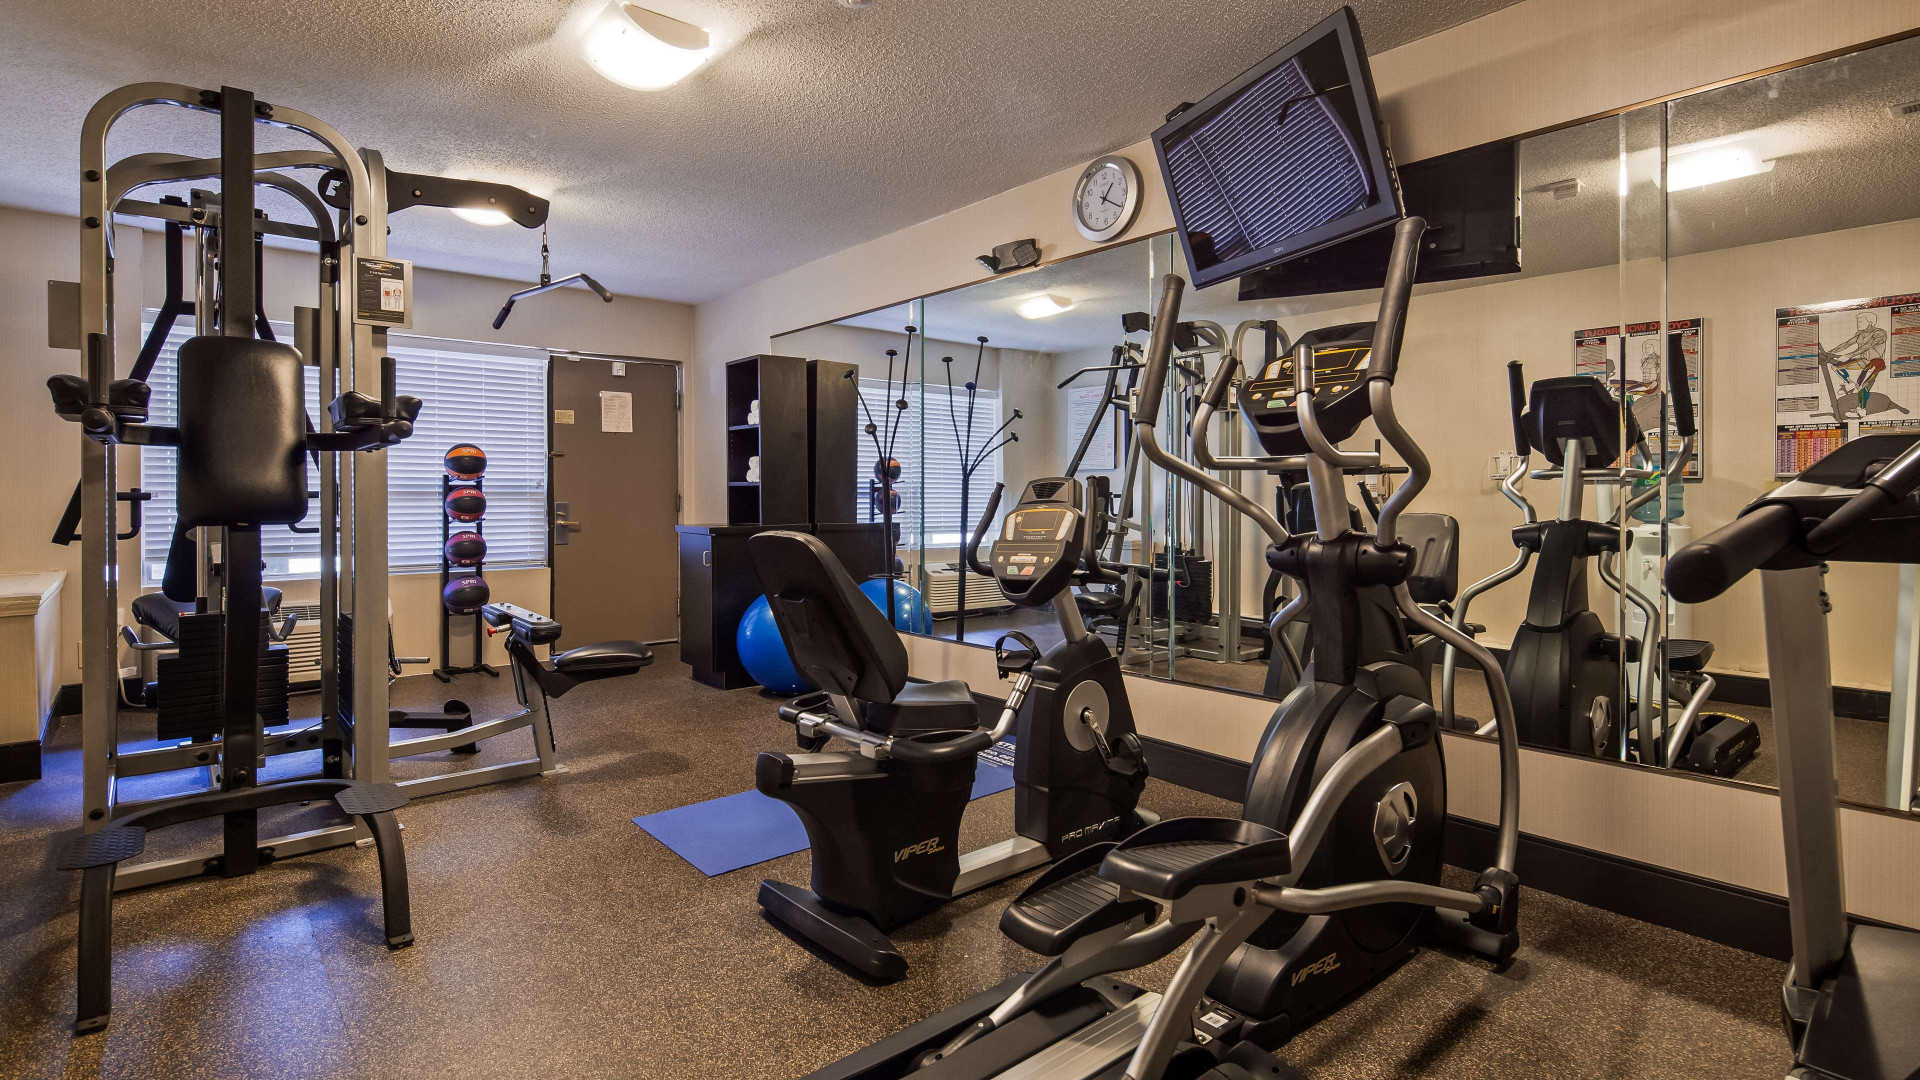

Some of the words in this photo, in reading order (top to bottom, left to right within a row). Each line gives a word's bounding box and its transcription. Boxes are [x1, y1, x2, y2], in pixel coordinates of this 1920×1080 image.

[894, 836, 940, 863] VIPER
[1061, 828, 1083, 844] PRO
[1291, 952, 1337, 987] VIPER
